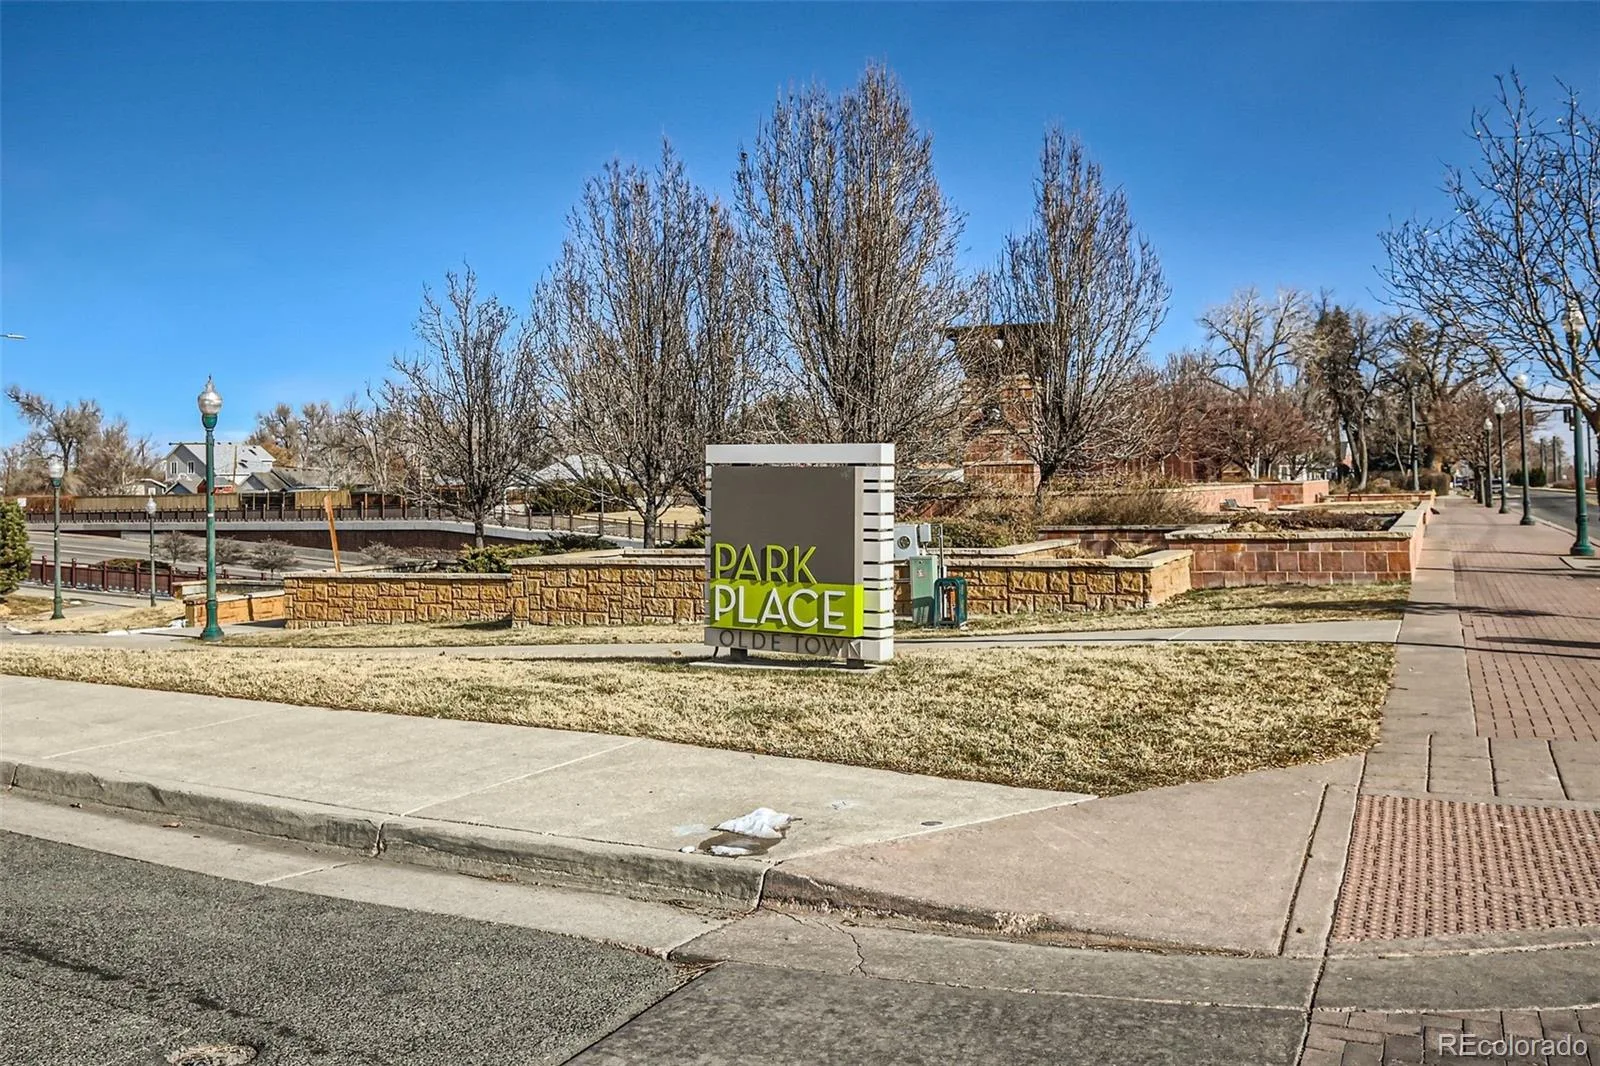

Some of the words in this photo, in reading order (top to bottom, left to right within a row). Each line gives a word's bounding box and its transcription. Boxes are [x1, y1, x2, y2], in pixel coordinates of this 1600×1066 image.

[714, 543, 818, 584] PARK
[714, 585, 847, 630] PLACE
[719, 630, 781, 650] OLDE
[791, 635, 863, 659] TOWN
